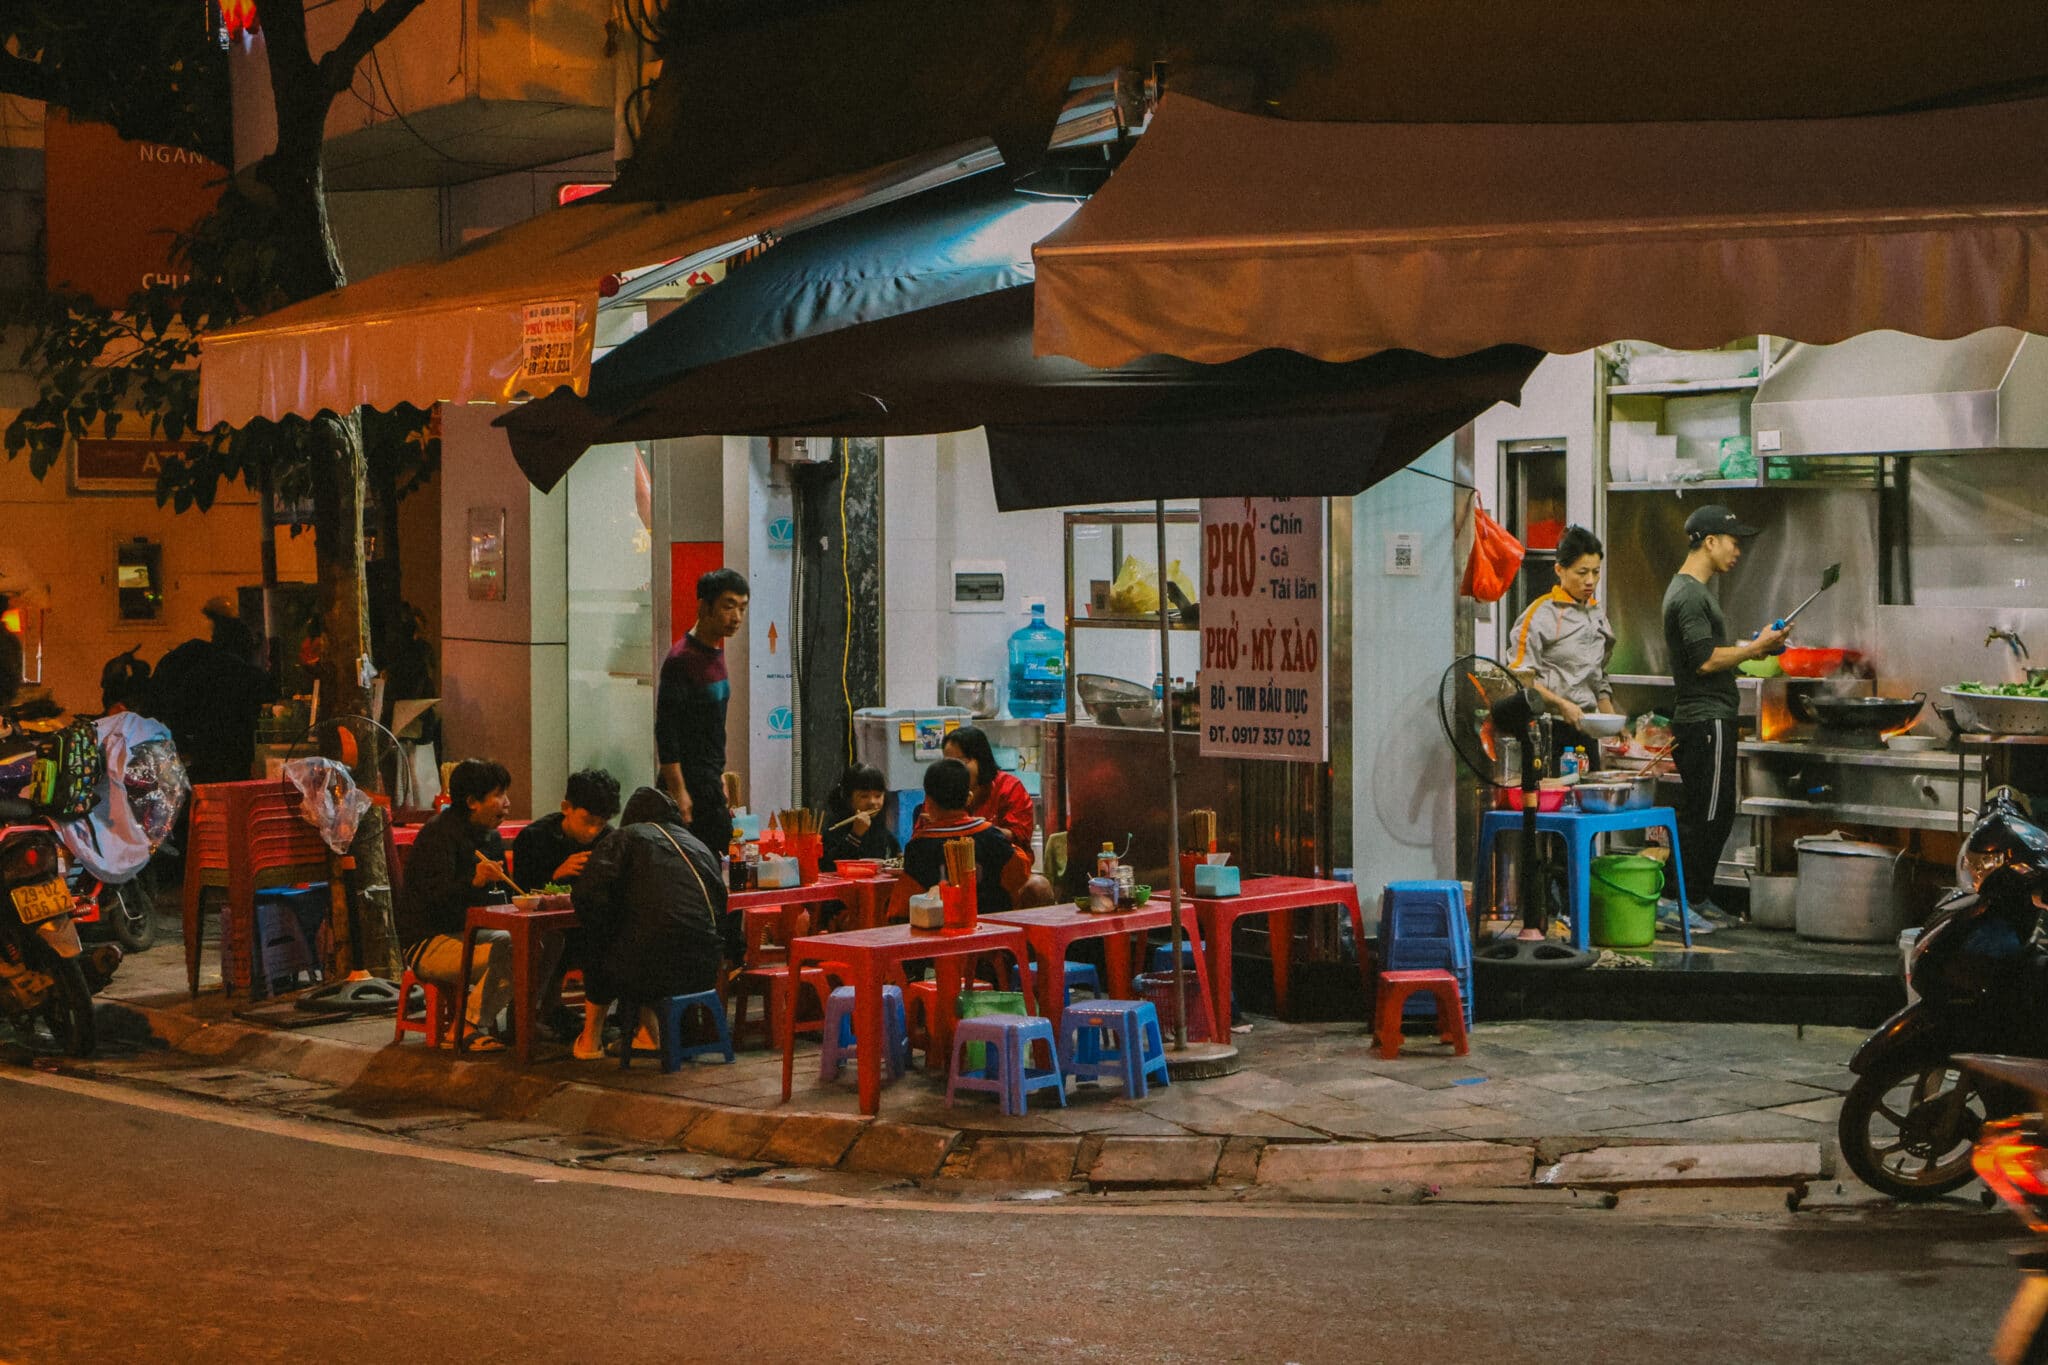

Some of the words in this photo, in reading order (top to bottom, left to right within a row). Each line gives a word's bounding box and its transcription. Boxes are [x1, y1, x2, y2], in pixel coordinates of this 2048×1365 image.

[1270, 513, 1302, 535] Chín
[1206, 497, 1257, 597] PHỞ
[1270, 578, 1291, 599] Tái
[1206, 610, 1239, 670] PHỞ
[1252, 617, 1277, 672] MỲ
[1281, 617, 1318, 672] XÀO
[1211, 681, 1226, 710] BÒ
[1236, 686, 1256, 711] TIM
[1285, 688, 1308, 719] DỤC
[1209, 726, 1229, 743] ĐT.
[1232, 726, 1260, 744] 0917
[1263, 728, 1284, 745] 337
[1287, 729, 1312, 747] 032
